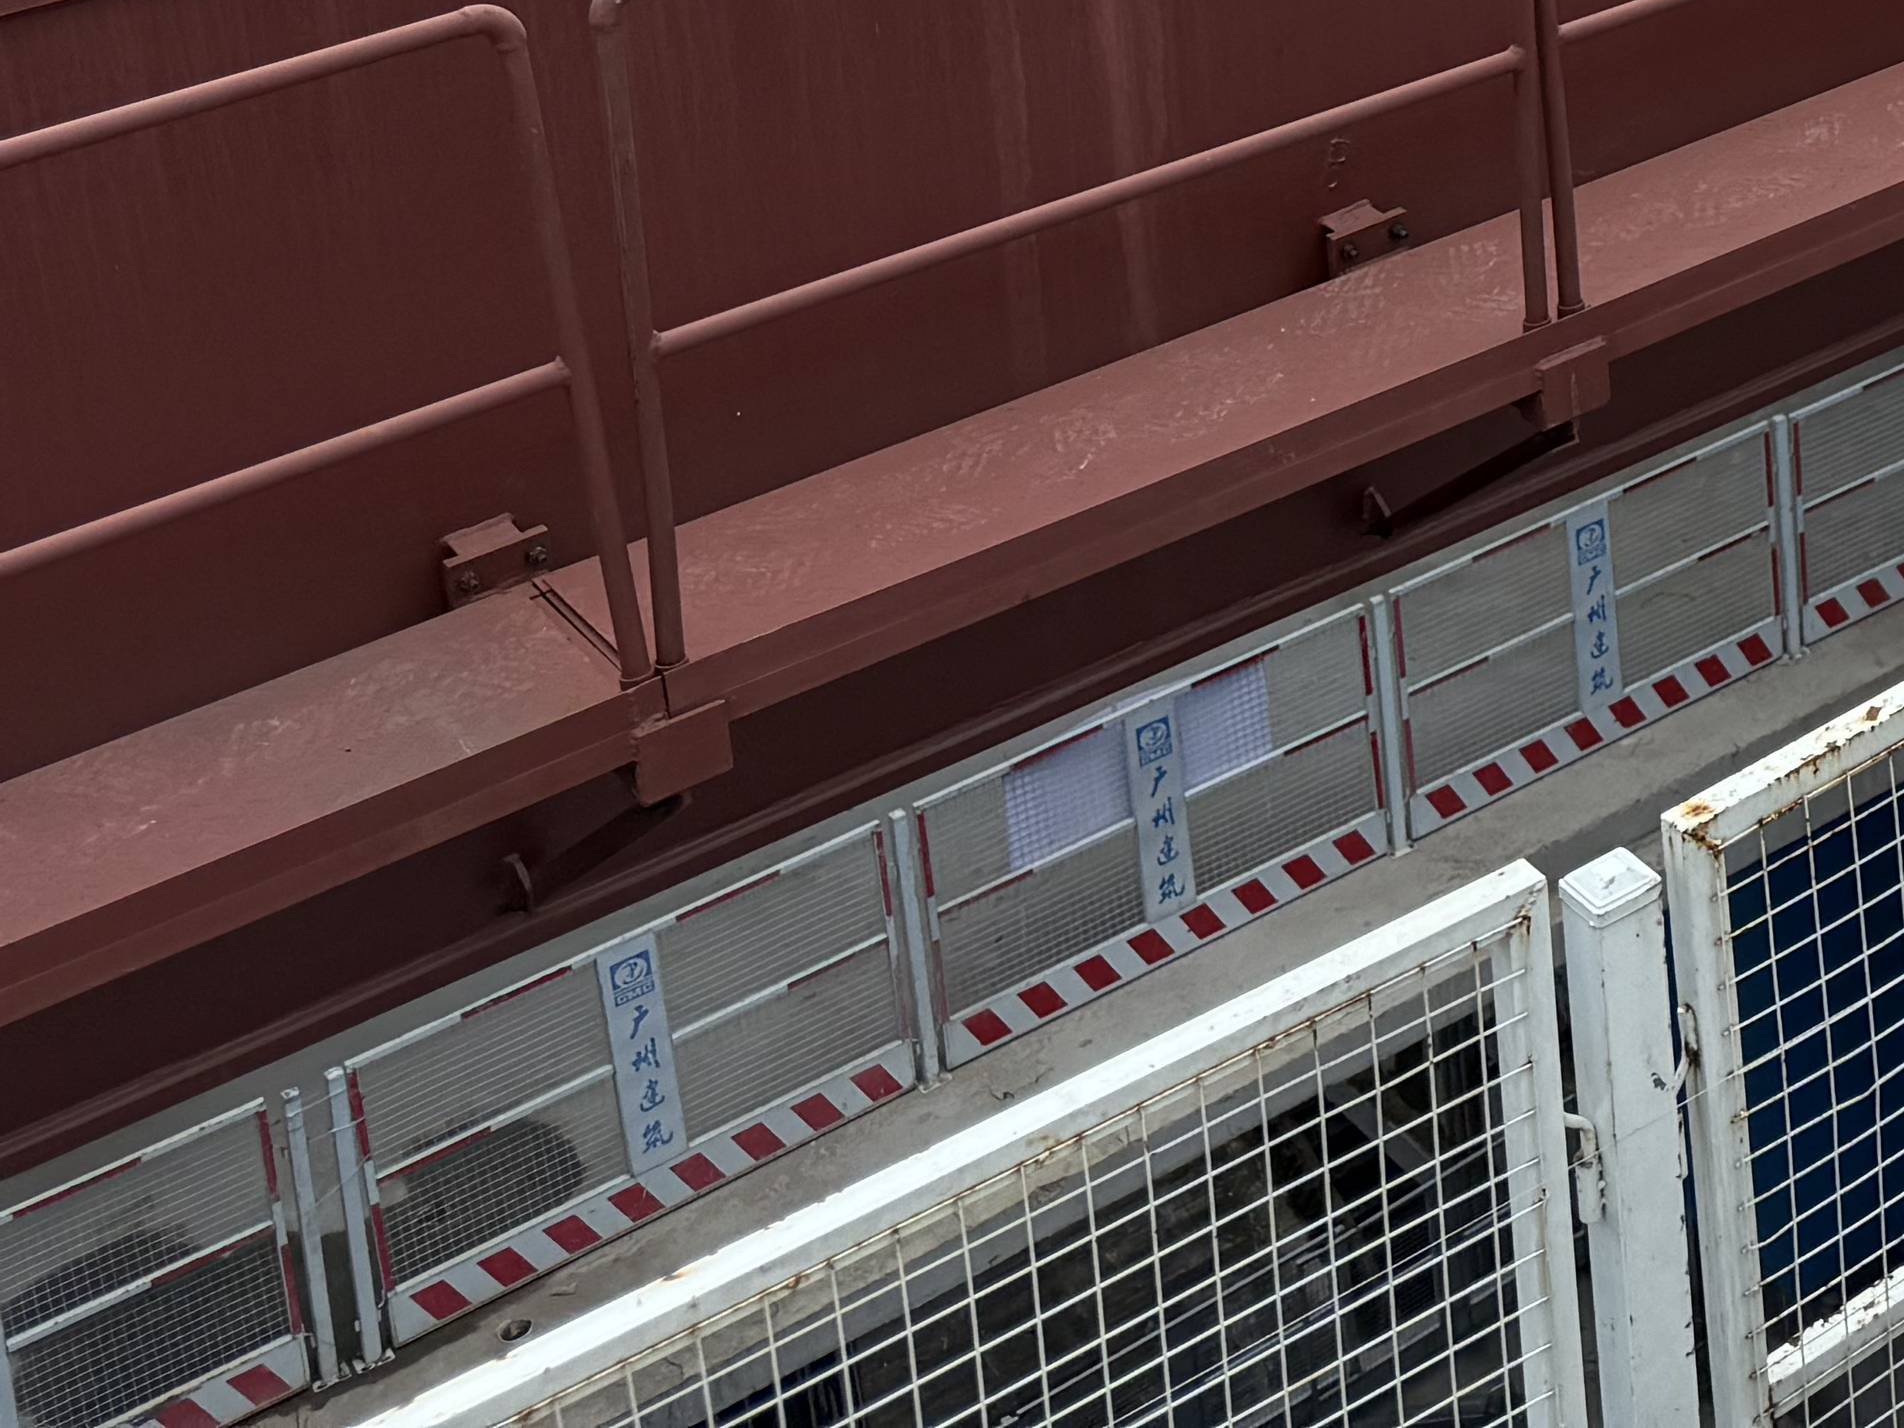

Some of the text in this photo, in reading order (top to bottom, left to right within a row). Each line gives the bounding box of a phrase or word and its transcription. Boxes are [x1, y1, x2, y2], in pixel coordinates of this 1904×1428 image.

[1586, 564, 1614, 696] 广州建筑
[1150, 764, 1186, 905] 广州建筑
[629, 1004, 674, 1155] 广州建筑
